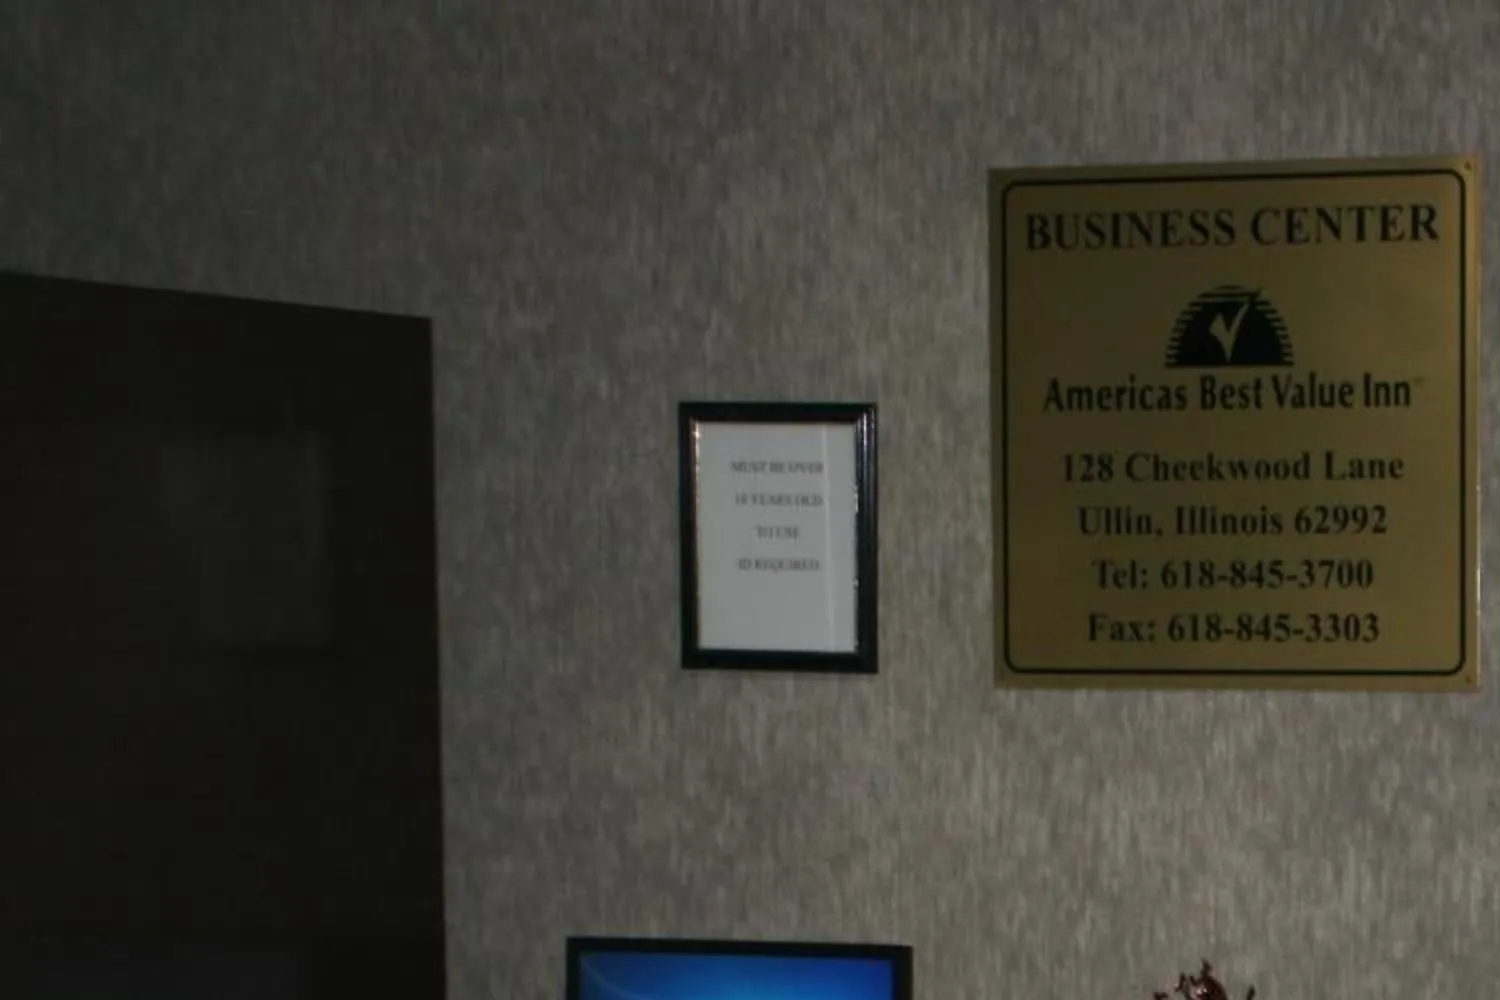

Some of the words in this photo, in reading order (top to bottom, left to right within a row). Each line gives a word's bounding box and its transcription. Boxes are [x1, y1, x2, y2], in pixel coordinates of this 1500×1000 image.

[1025, 208, 1238, 252] BUSINESS
[1250, 203, 1441, 246] CENTER
[1043, 374, 1188, 412] Americas
[1200, 374, 1264, 411] Best
[1272, 374, 1355, 409] Value
[1364, 371, 1412, 408] Inn
[1062, 453, 1115, 484] 128
[1125, 452, 1312, 483] Cheekwood
[1324, 451, 1405, 481] Lane
[1078, 506, 1164, 538] Ullin,
[1175, 506, 1285, 536] Illinois
[1294, 504, 1388, 535] 62992
[1092, 560, 1149, 590] Tel:
[1161, 558, 1374, 590] 618-845-3700
[1087, 613, 1156, 642] Fax:
[1167, 612, 1381, 643] 618-845-3303
